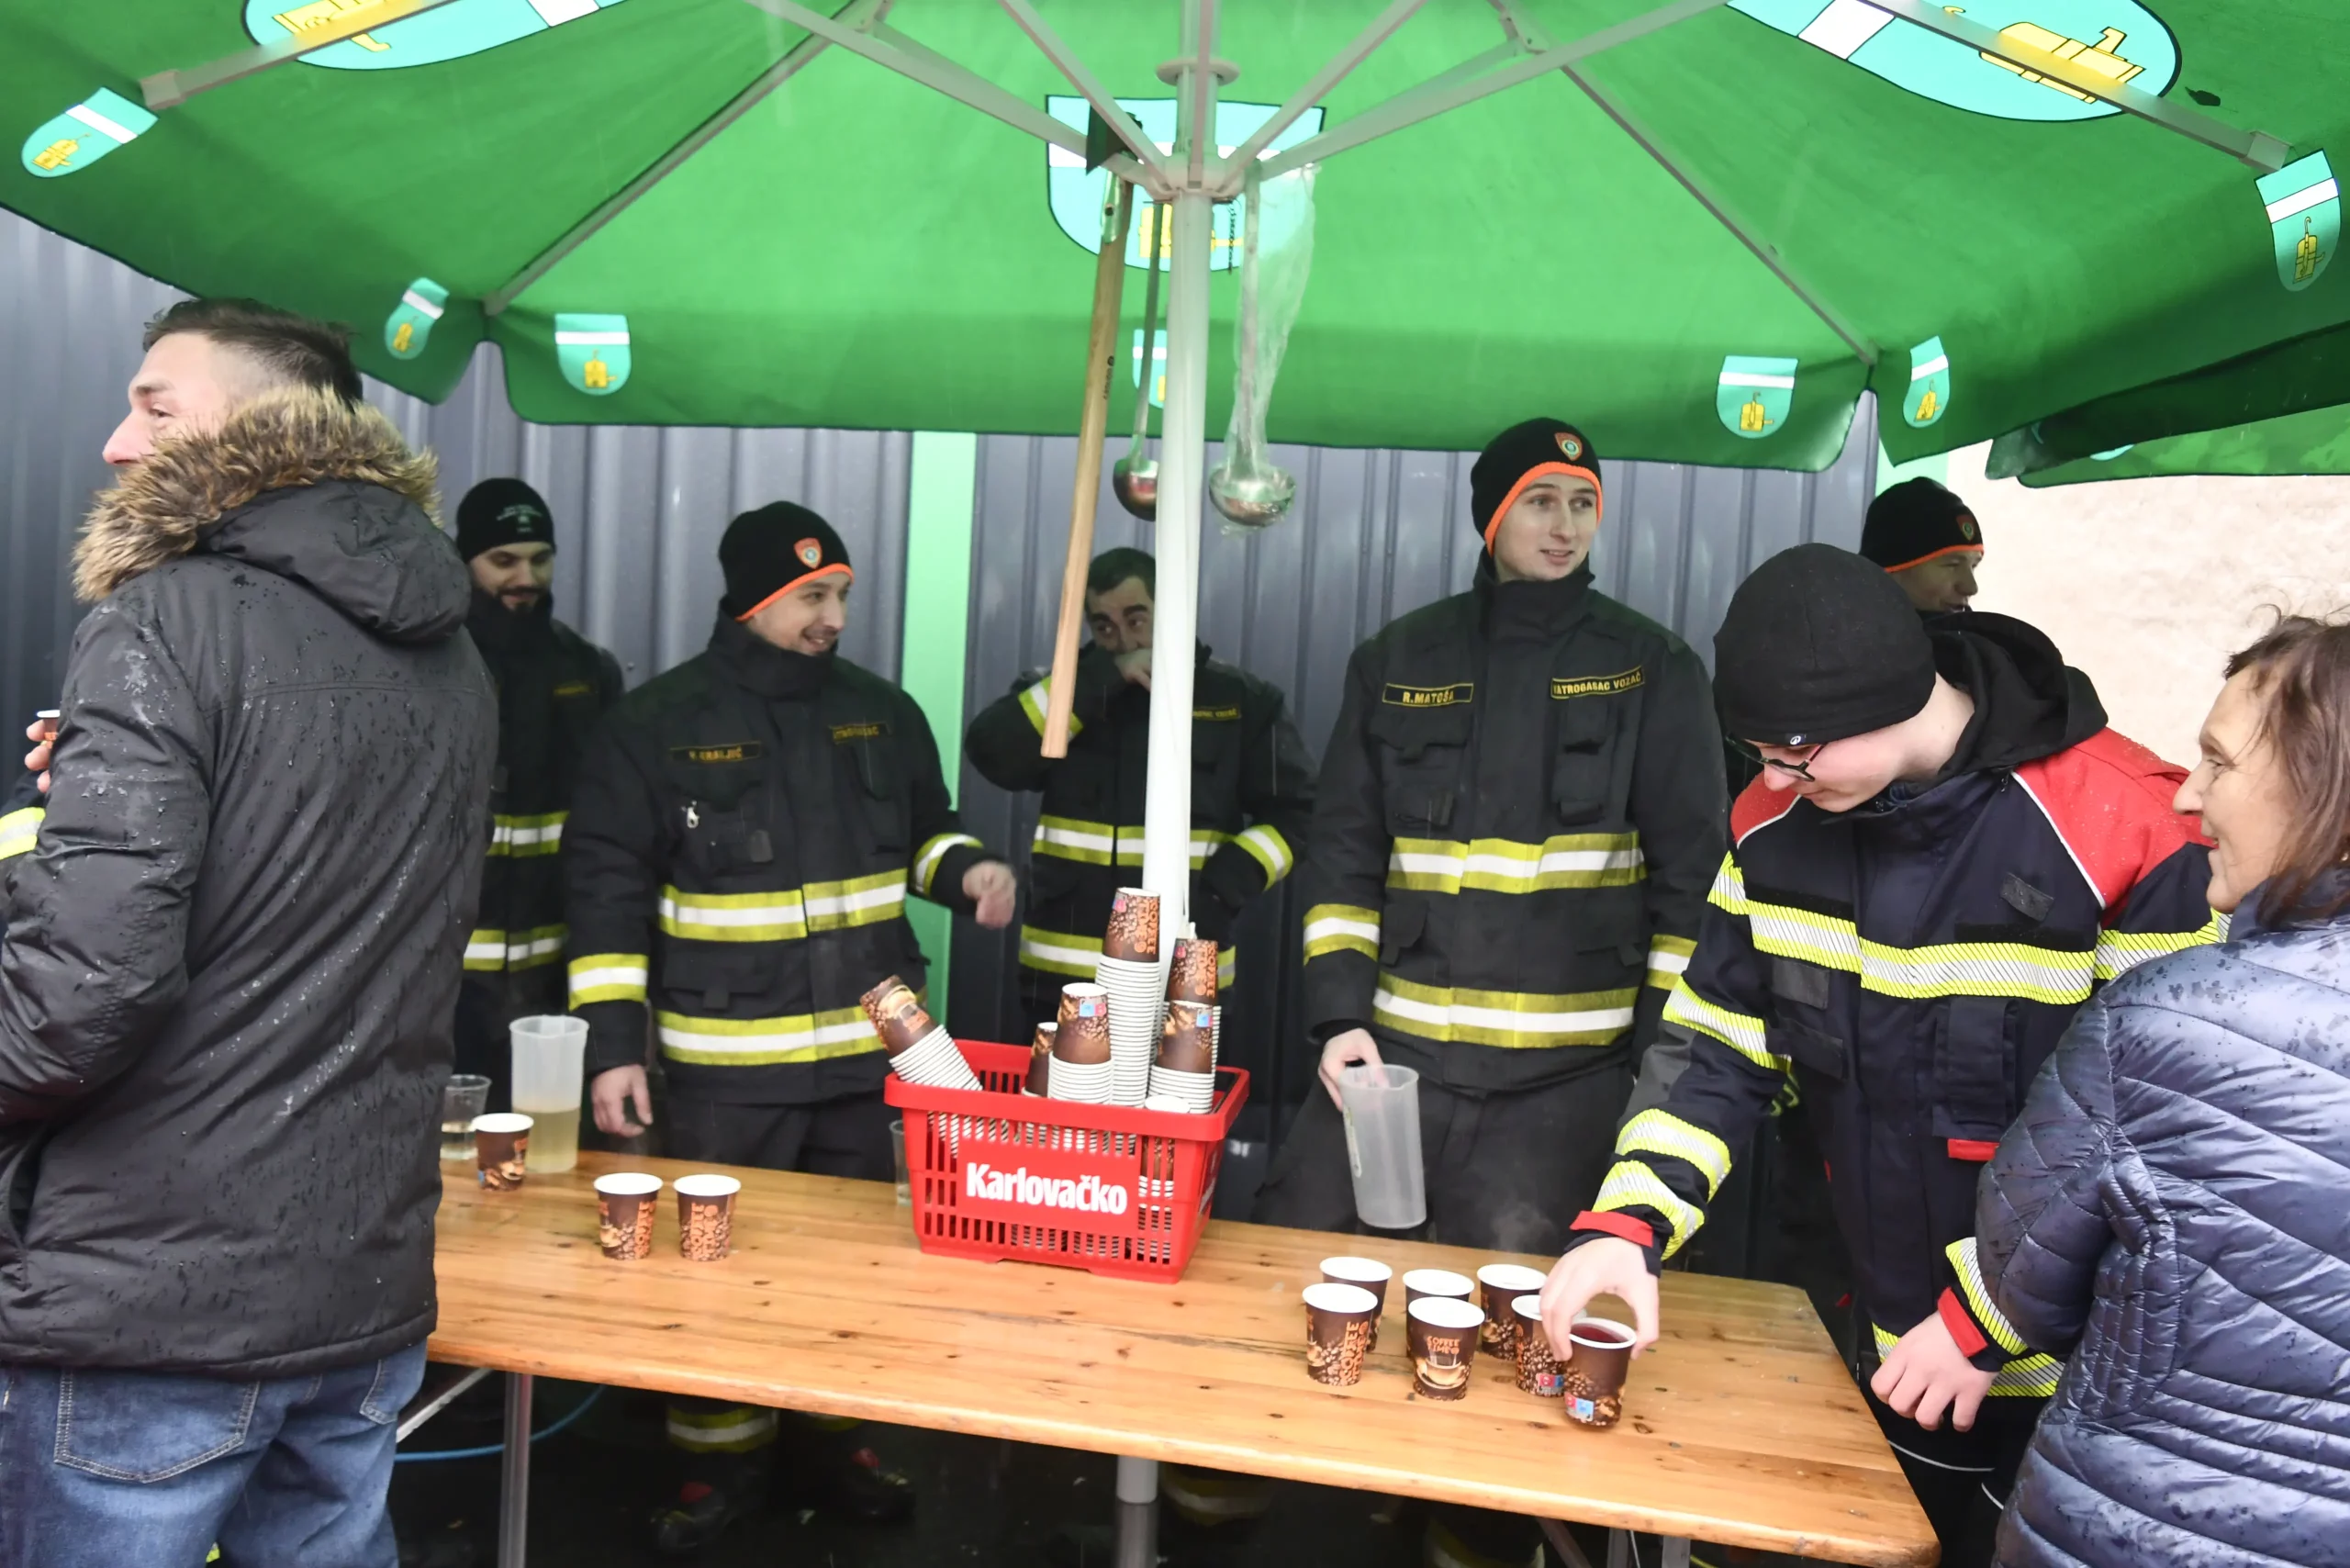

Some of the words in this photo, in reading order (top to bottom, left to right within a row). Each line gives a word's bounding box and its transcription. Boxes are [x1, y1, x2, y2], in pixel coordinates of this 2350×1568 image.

[1613, 670, 1641, 689] VOZAČ
[1402, 689, 1454, 705] R.MATOŠA
[967, 1162, 1127, 1215] Karlovačko
[1339, 1321, 1360, 1379] COFFEE
[1427, 1336, 1460, 1347] COFFEE
